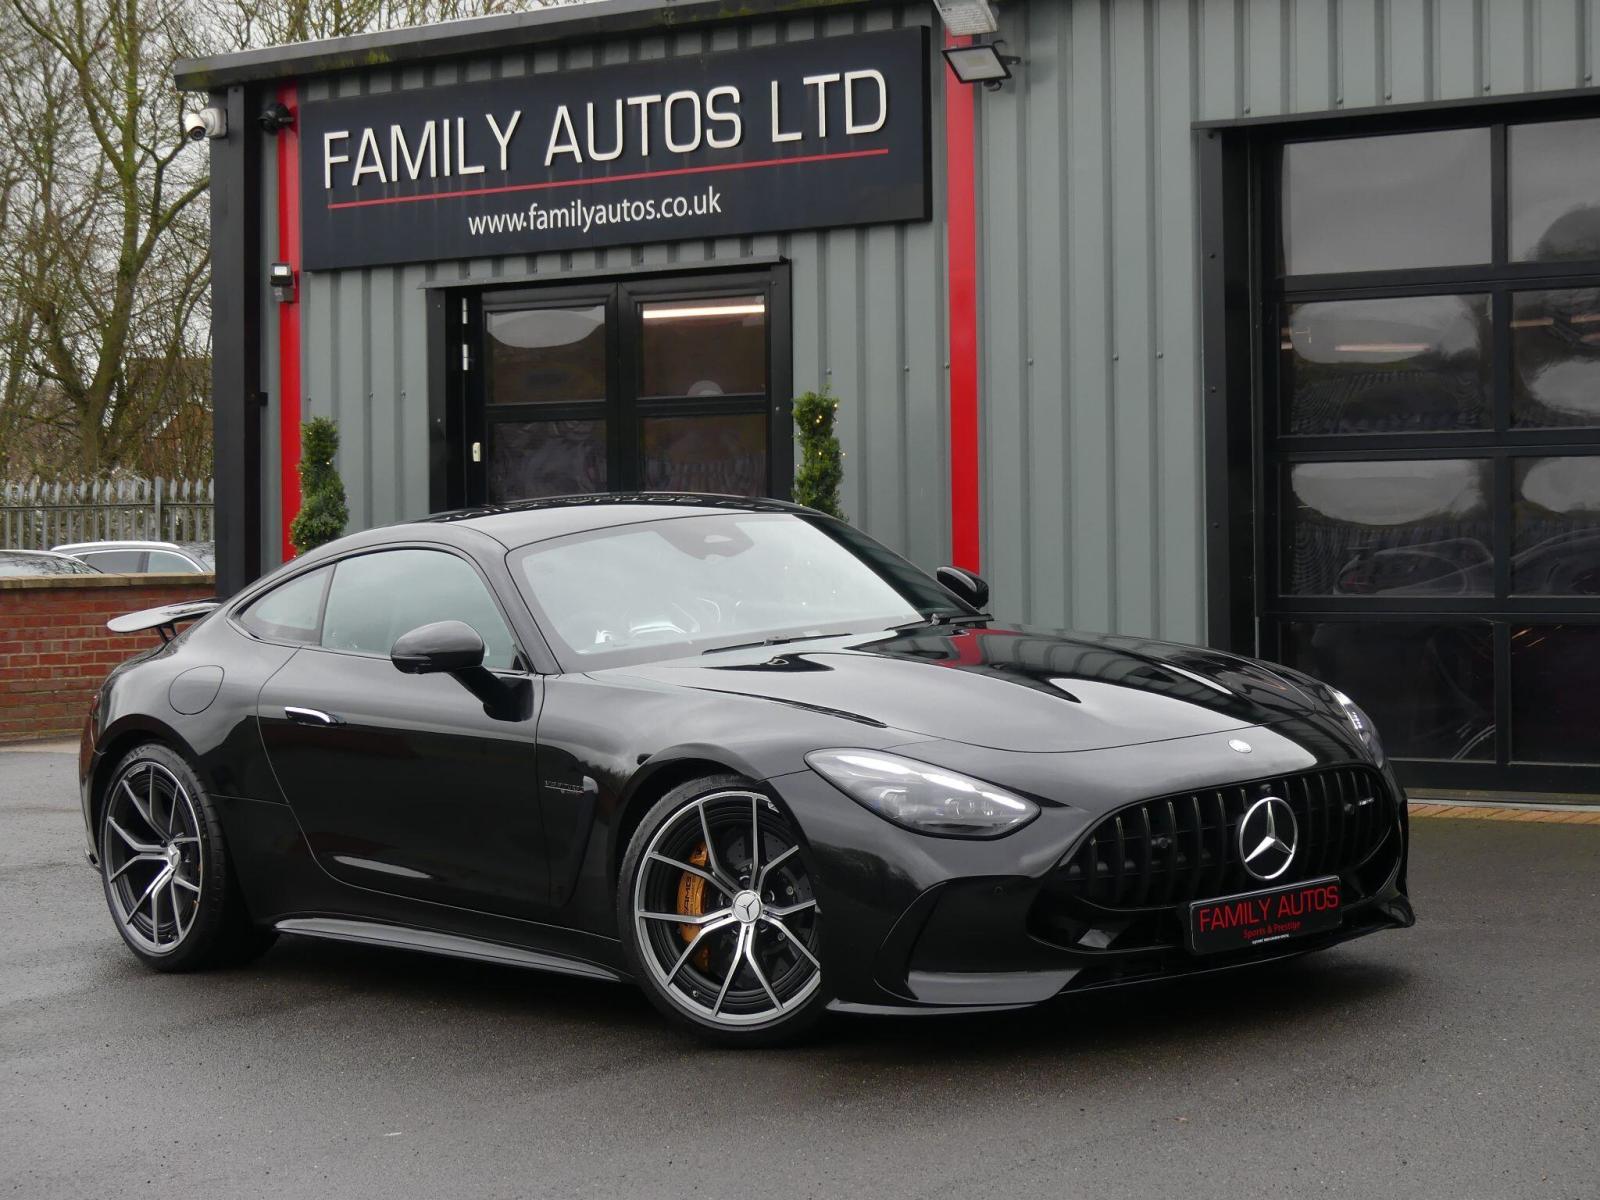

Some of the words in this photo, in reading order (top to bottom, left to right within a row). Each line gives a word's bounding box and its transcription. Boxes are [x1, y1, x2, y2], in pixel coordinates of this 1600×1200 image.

[323, 110, 521, 189] FAMILY
[544, 85, 742, 166] AUTOS
[771, 69, 887, 143] LTD
[468, 186, 722, 234] www.familyautos.co.uk
[1199, 898, 1271, 932] FAMILY
[1277, 886, 1339, 918] AUTOS
